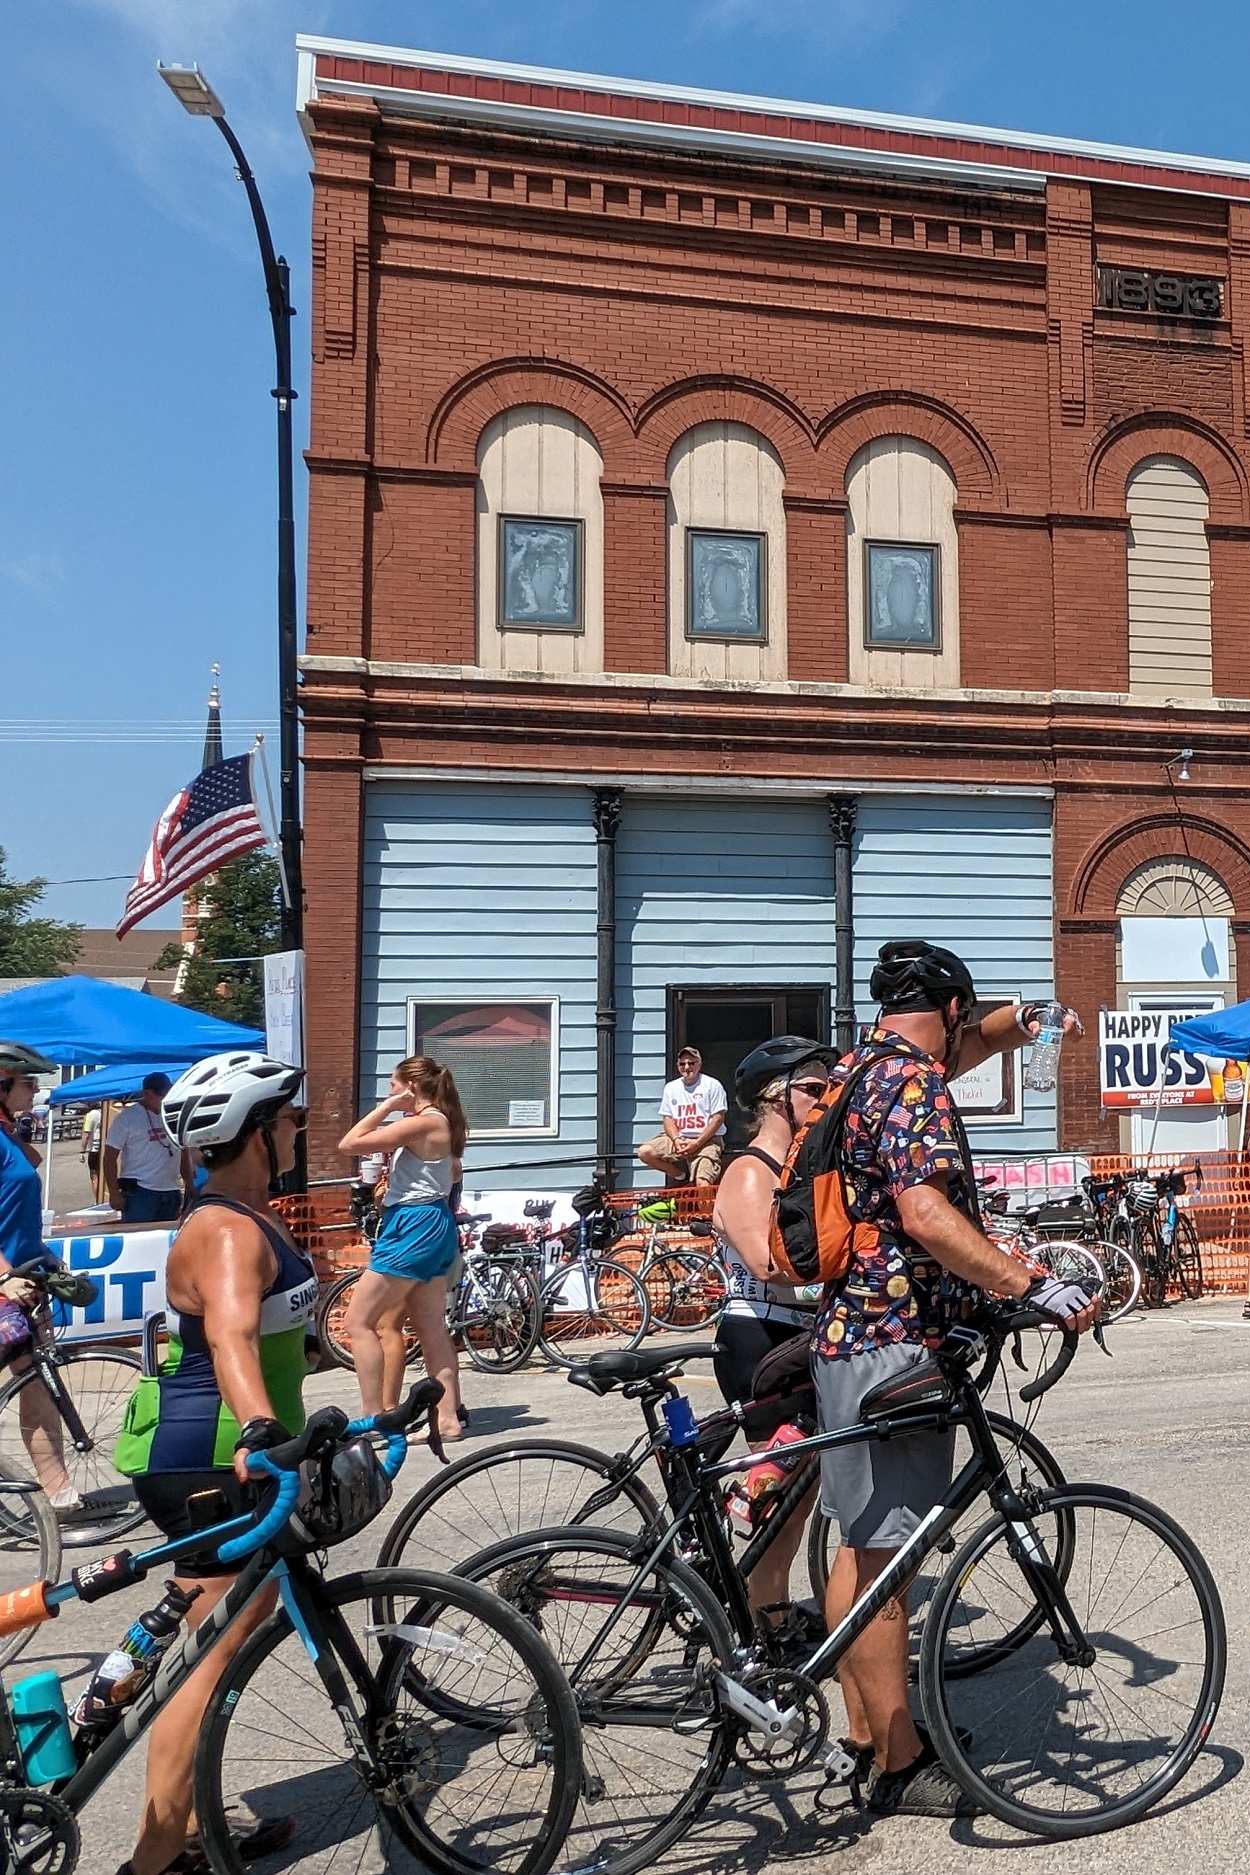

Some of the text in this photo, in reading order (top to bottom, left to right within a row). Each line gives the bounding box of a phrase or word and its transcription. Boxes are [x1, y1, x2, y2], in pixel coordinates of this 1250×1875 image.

[1105, 1015, 1161, 1038] HAPPY
[1105, 1042, 1205, 1087] RUSS
[1162, 1097, 1183, 1105] PLACE
[337, 1705, 375, 1768] FELT
